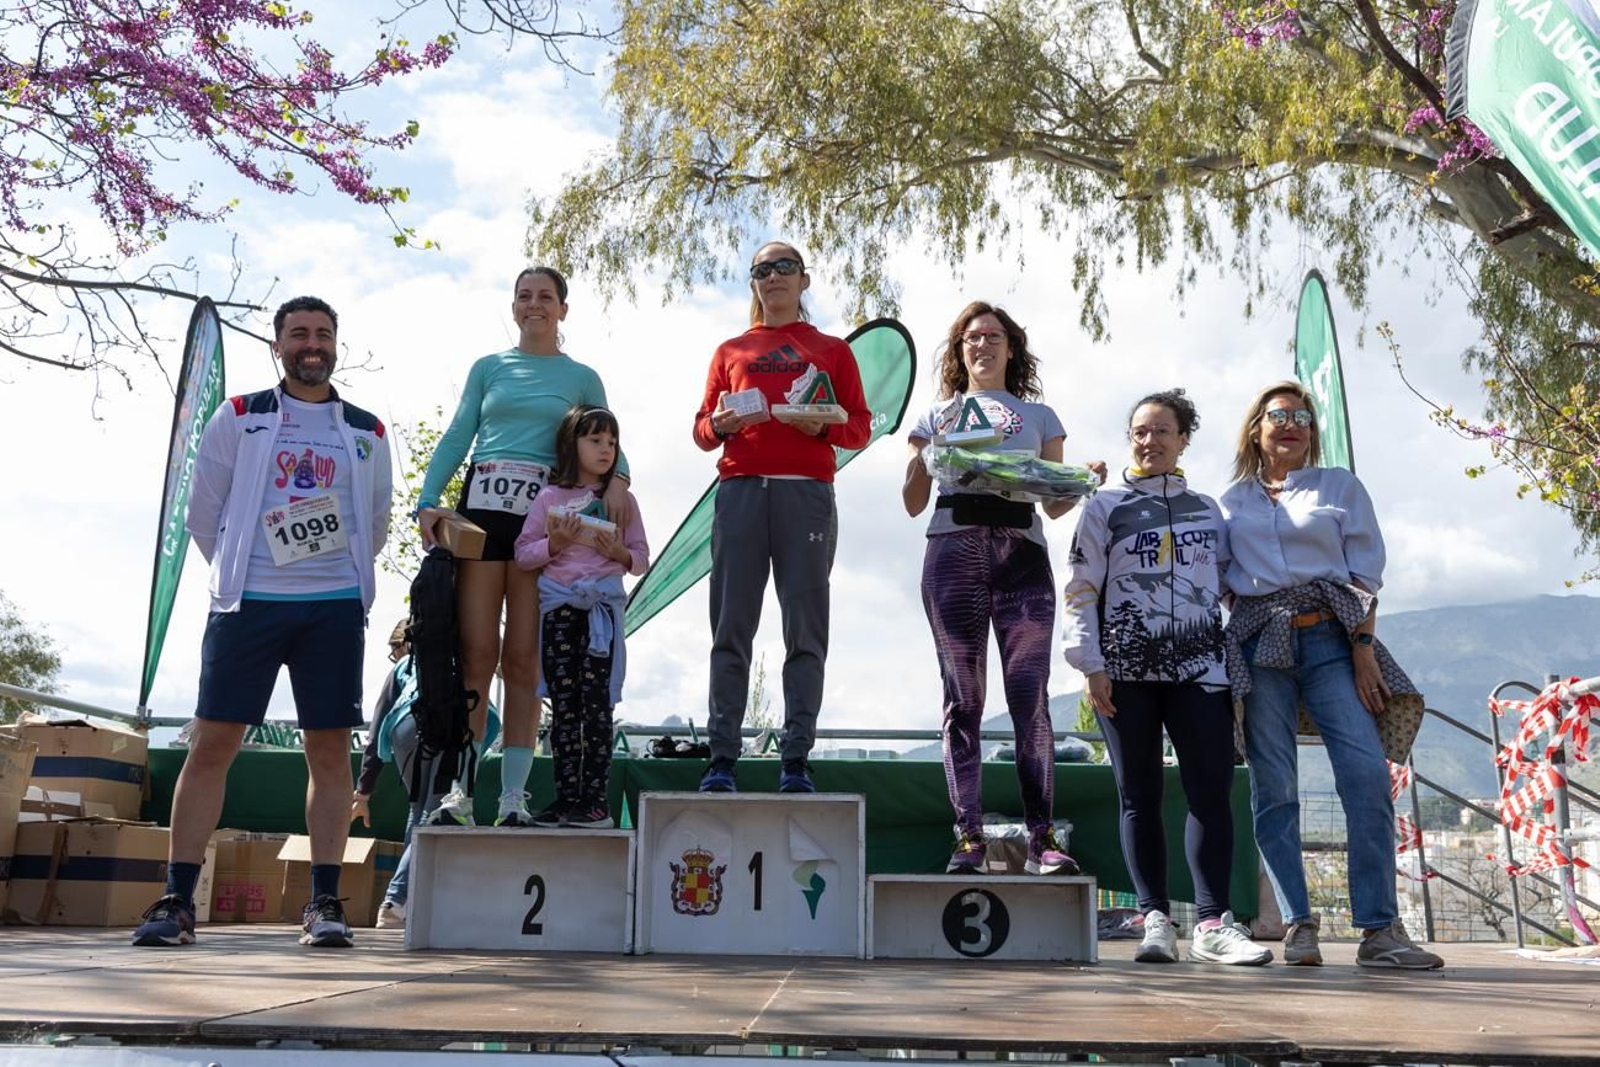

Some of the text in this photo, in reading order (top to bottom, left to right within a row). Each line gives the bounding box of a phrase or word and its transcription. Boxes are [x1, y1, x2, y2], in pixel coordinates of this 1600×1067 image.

[189, 359, 218, 452] POPULAR
[479, 477, 541, 501] 1078
[275, 514, 339, 546] 1098
[521, 874, 546, 935] 2
[748, 851, 762, 911] 1
[959, 892, 993, 953] 3
